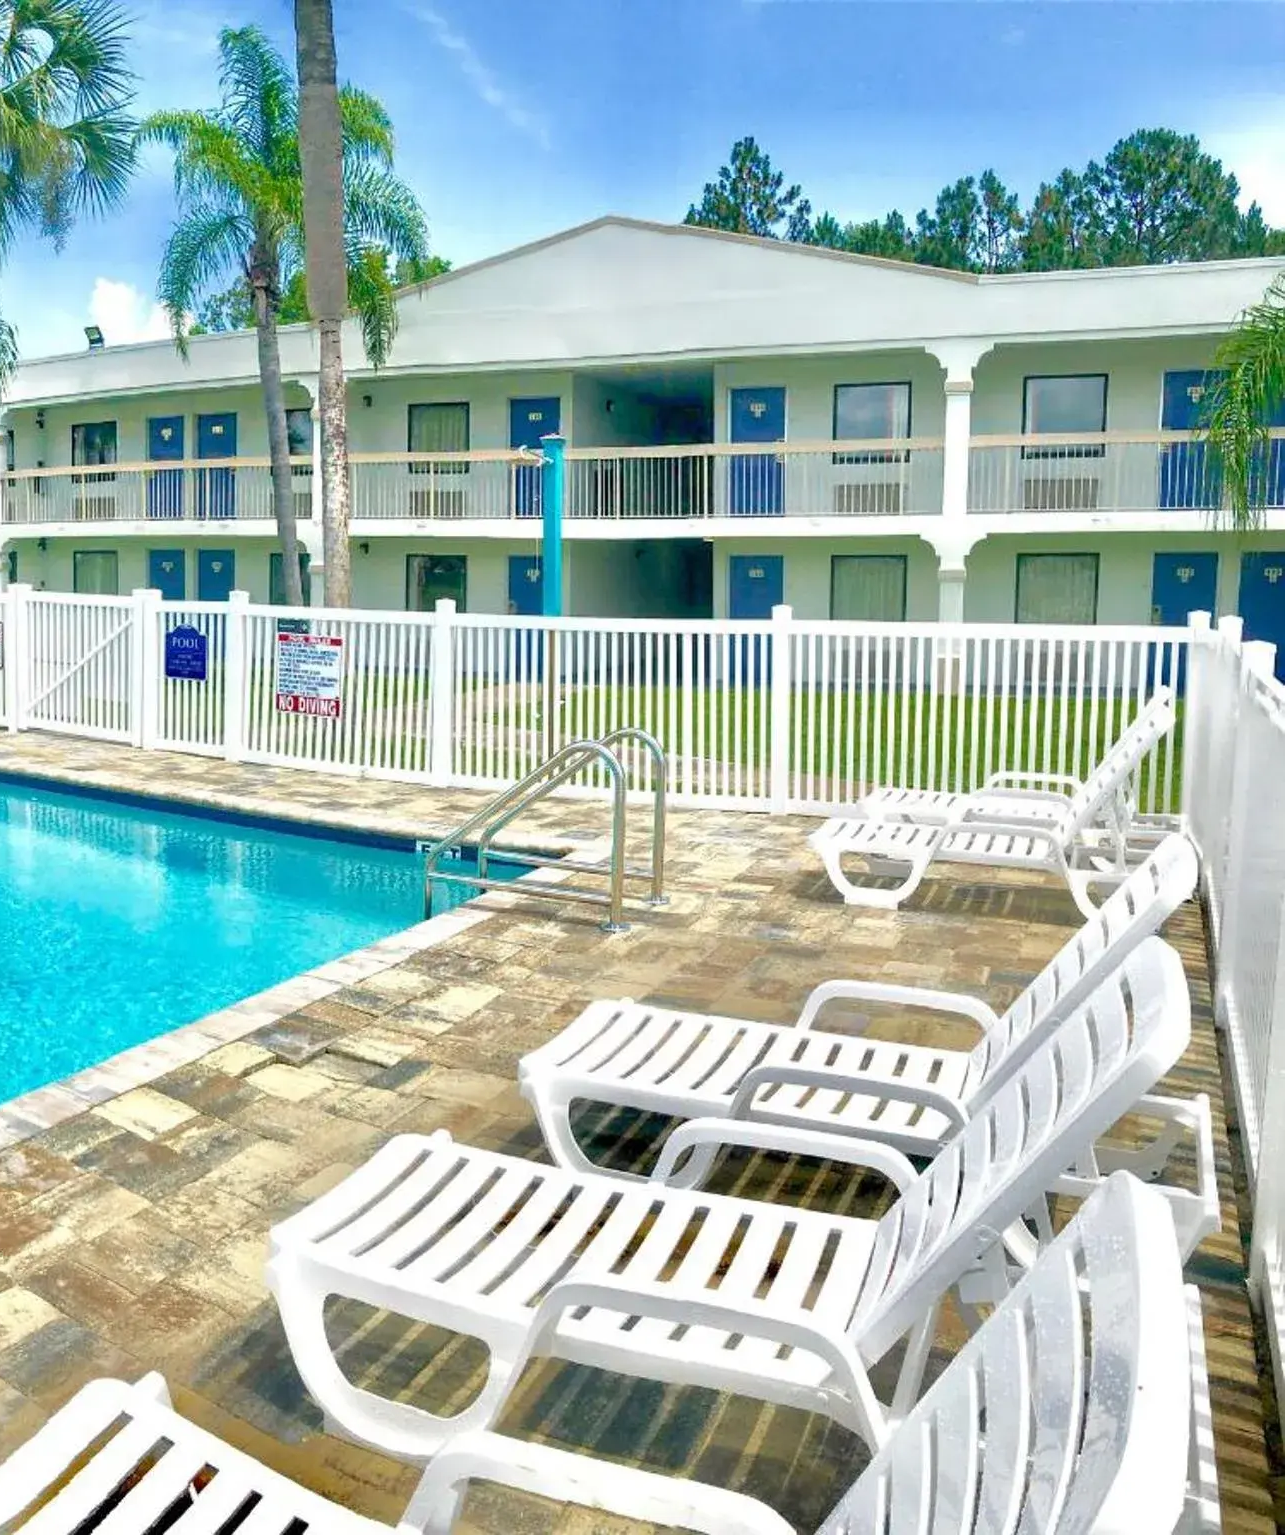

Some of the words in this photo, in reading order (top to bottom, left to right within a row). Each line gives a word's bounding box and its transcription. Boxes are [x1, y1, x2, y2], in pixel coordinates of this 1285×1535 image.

[172, 636, 199, 649] POOL
[279, 695, 294, 711] NO
[299, 697, 337, 715] DIVING
